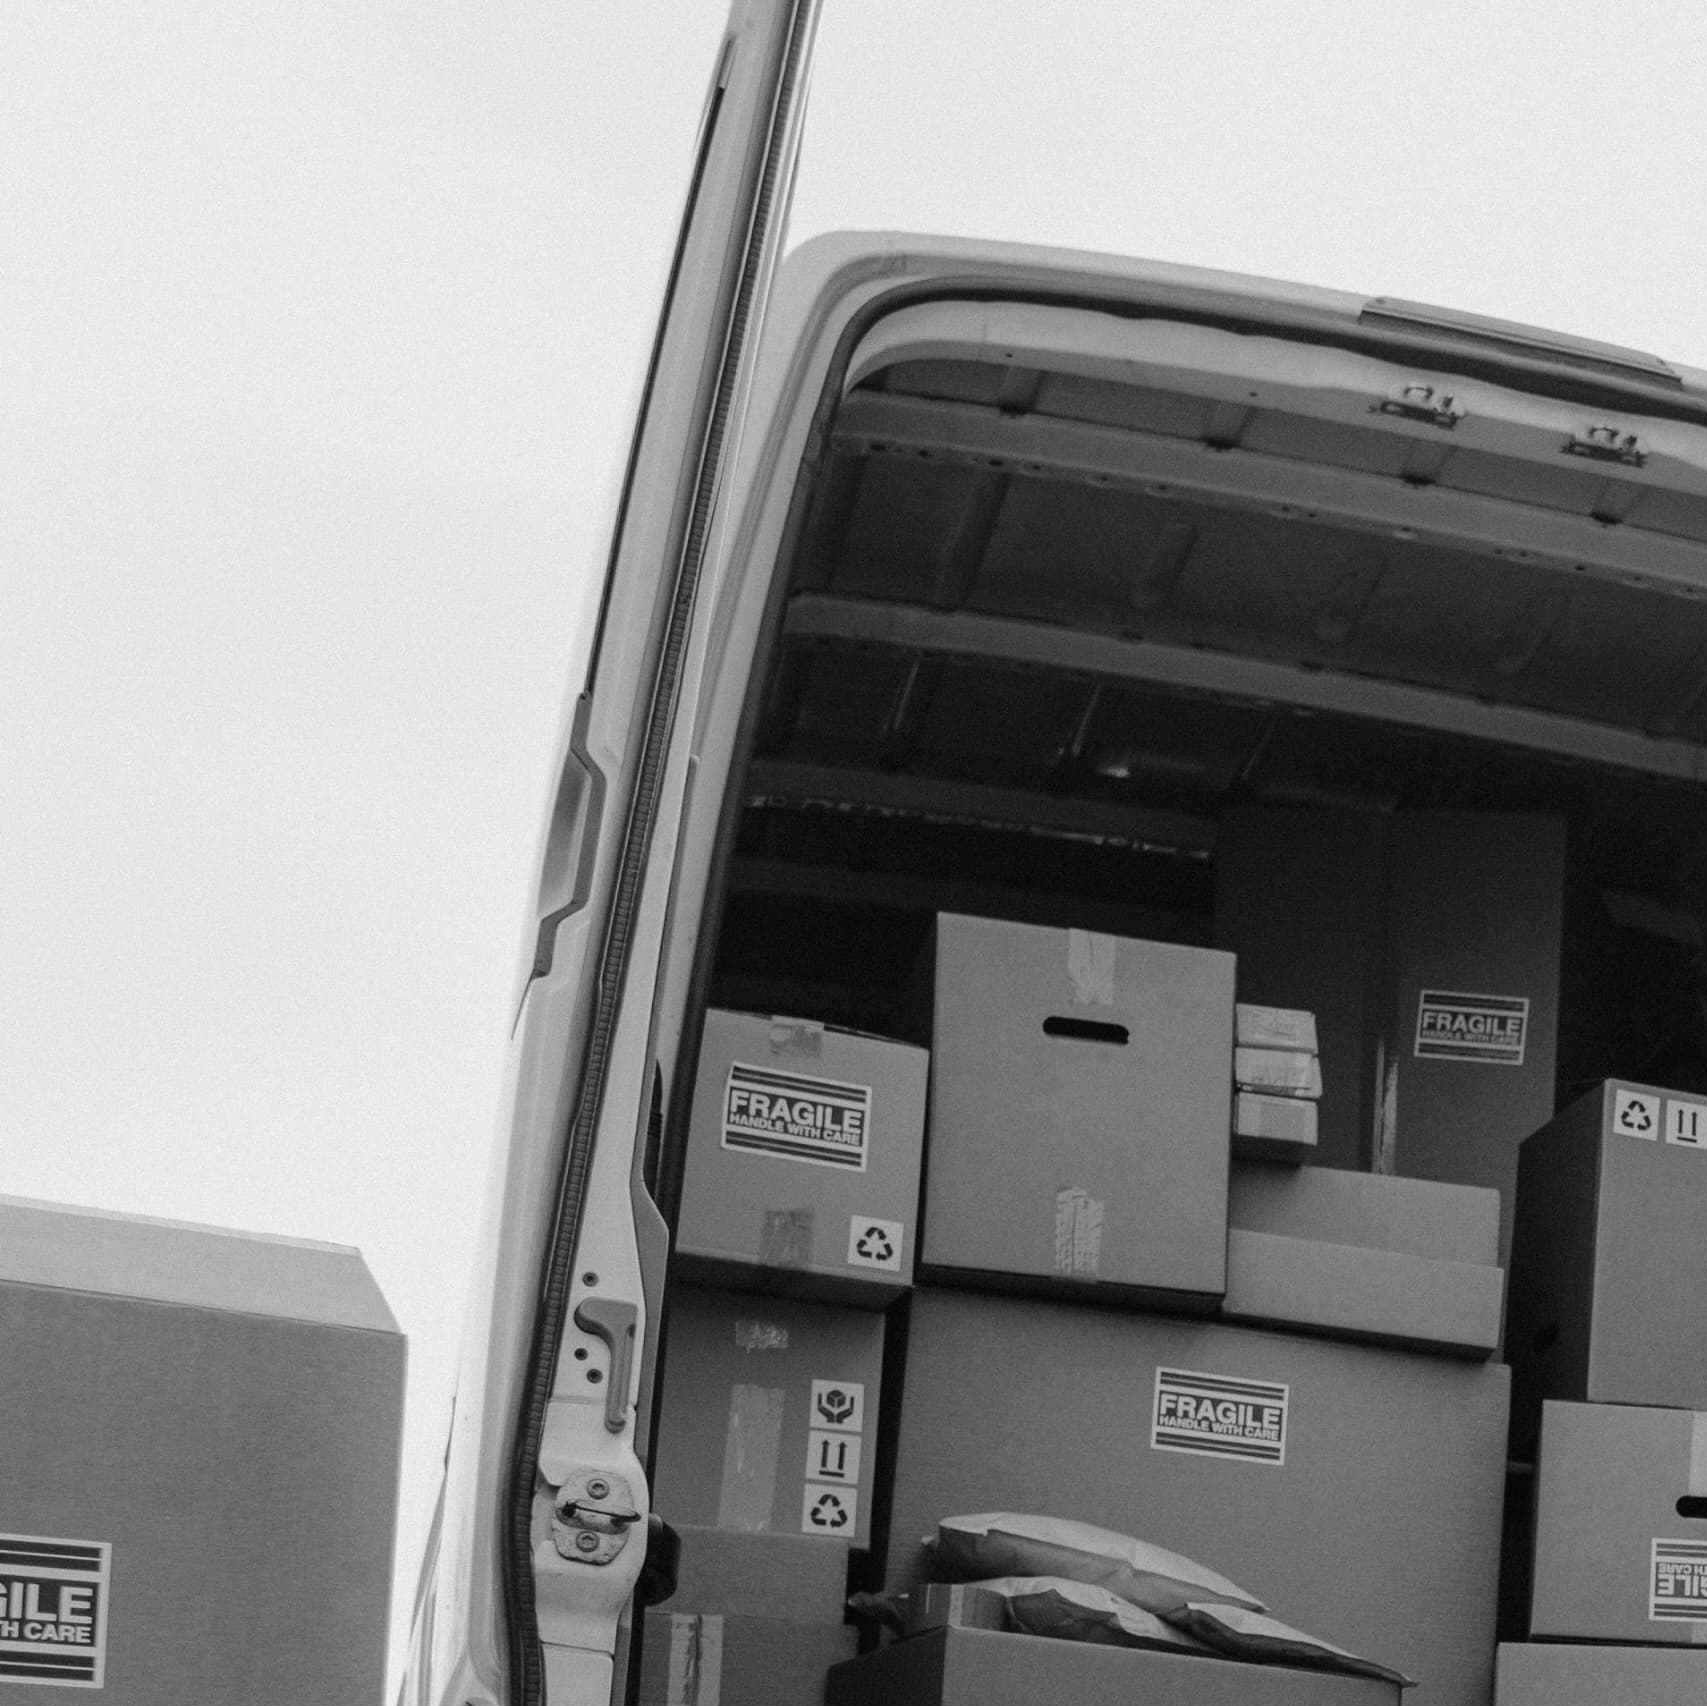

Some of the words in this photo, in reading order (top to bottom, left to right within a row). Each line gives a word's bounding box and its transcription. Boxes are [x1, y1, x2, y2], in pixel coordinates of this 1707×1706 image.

[1423, 1011, 1520, 1036] FRAGILE
[731, 1089, 862, 1134] FRAGILE
[729, 1113, 784, 1132] HANDLE
[787, 1123, 820, 1139] WITH
[823, 1130, 860, 1146] CARE
[1160, 1393, 1280, 1430] FRAGILE
[1159, 1415, 1209, 1431] HANDLE
[1212, 1422, 1243, 1436] WITH
[1244, 1426, 1279, 1440] CARE
[1659, 1563, 1692, 1574] CARE
[23, 1622, 91, 1643] CARE
